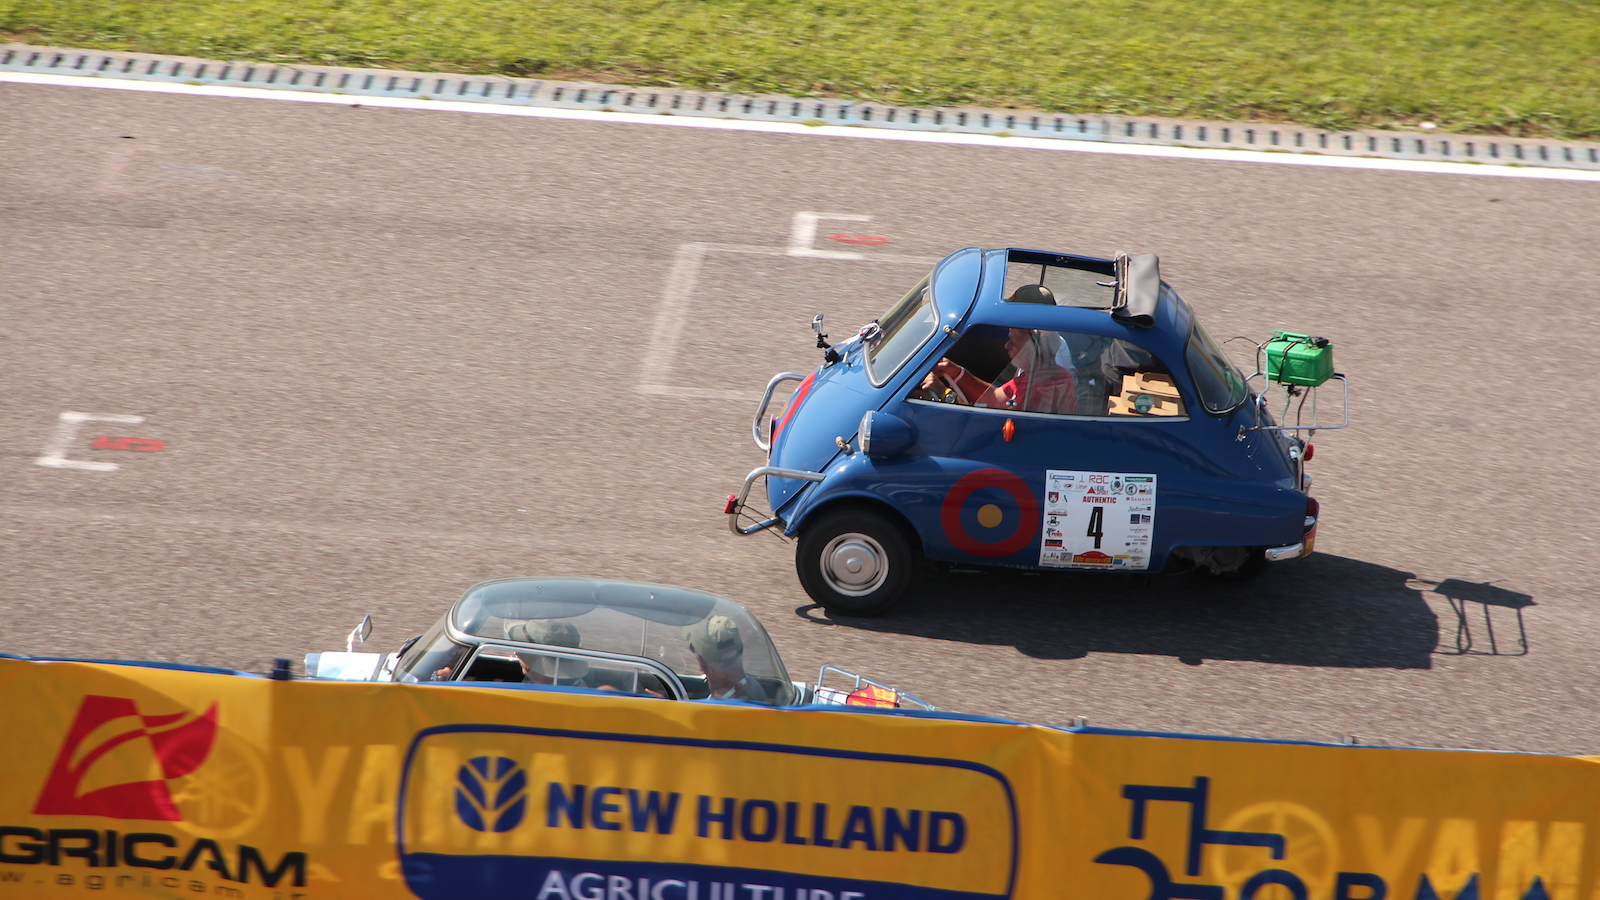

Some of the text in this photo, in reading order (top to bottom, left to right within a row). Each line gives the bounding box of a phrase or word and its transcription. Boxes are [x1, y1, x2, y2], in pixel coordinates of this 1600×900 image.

[1082, 496, 1117, 504] AUTHENTIC
[1086, 506, 1104, 549] 4
[545, 781, 969, 854] NEW HOLLAND
